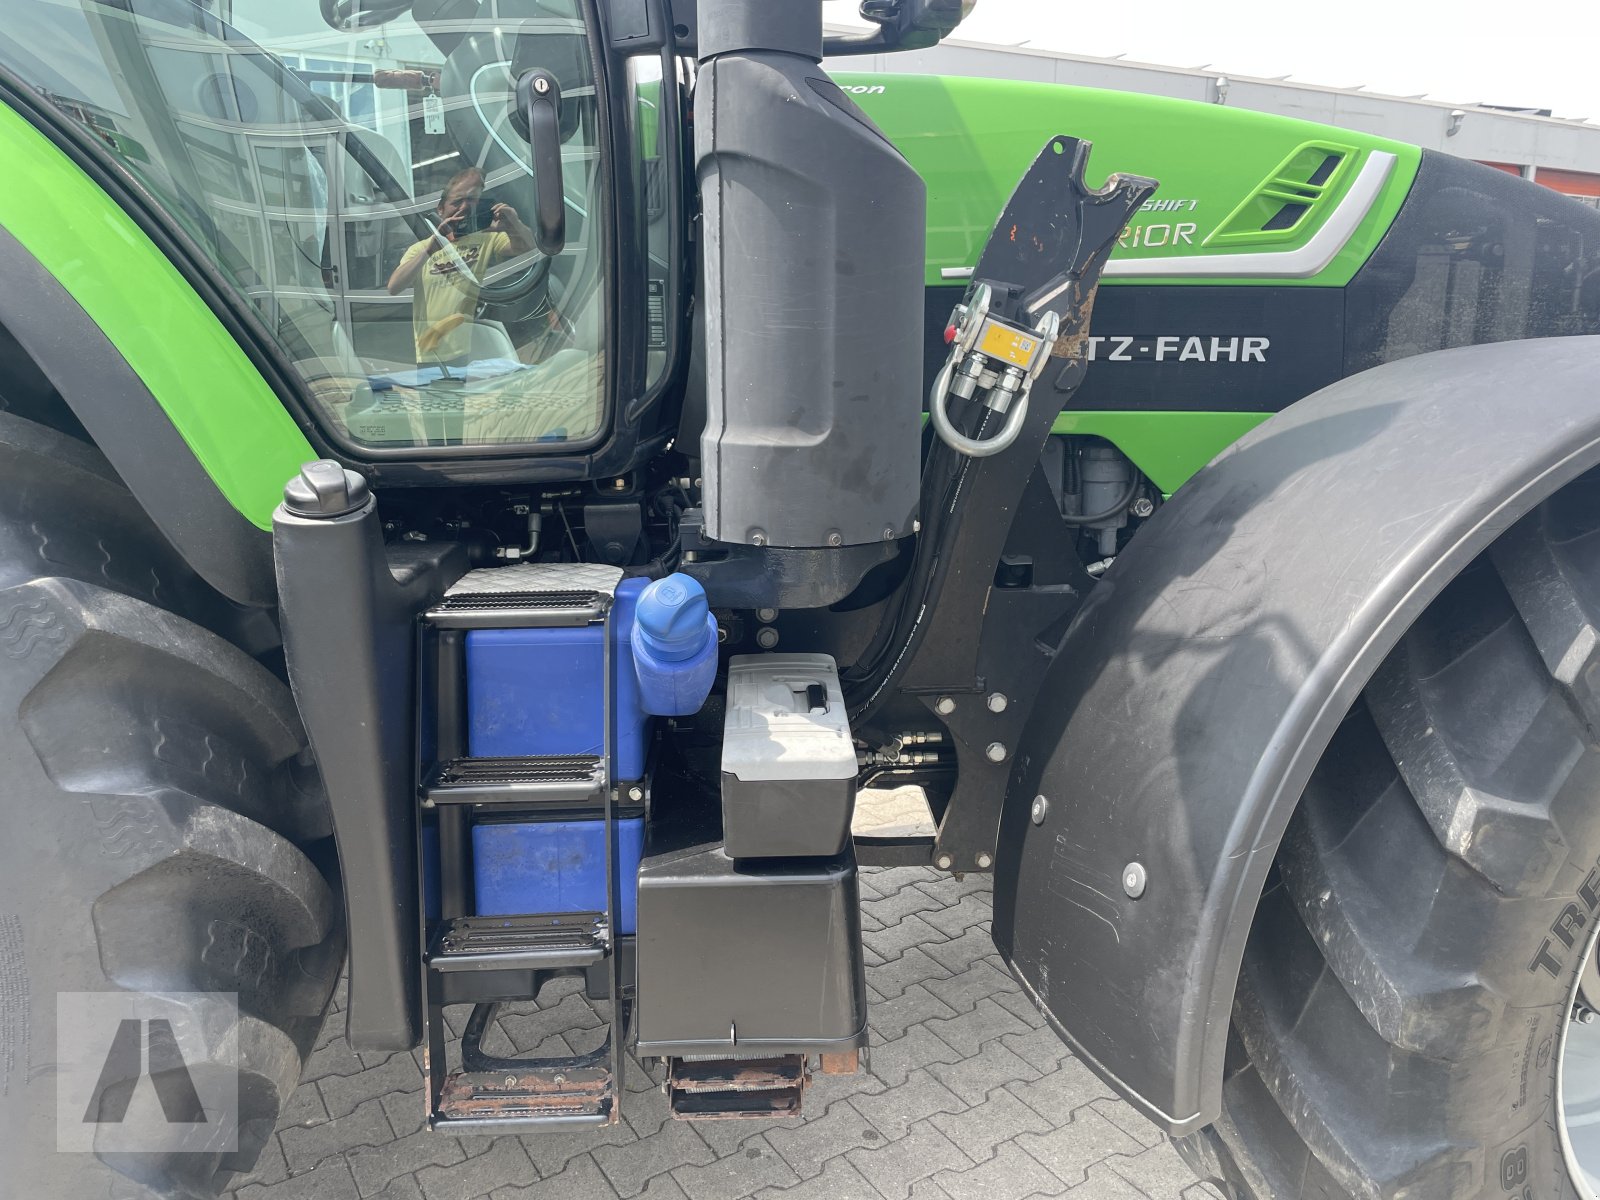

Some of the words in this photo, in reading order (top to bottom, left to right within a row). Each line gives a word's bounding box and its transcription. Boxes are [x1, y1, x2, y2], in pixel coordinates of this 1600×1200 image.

[1140, 199, 1199, 211] SHIFT
[1087, 336, 1270, 363] TZ-FAHR
[1527, 852, 1600, 979] TRE
